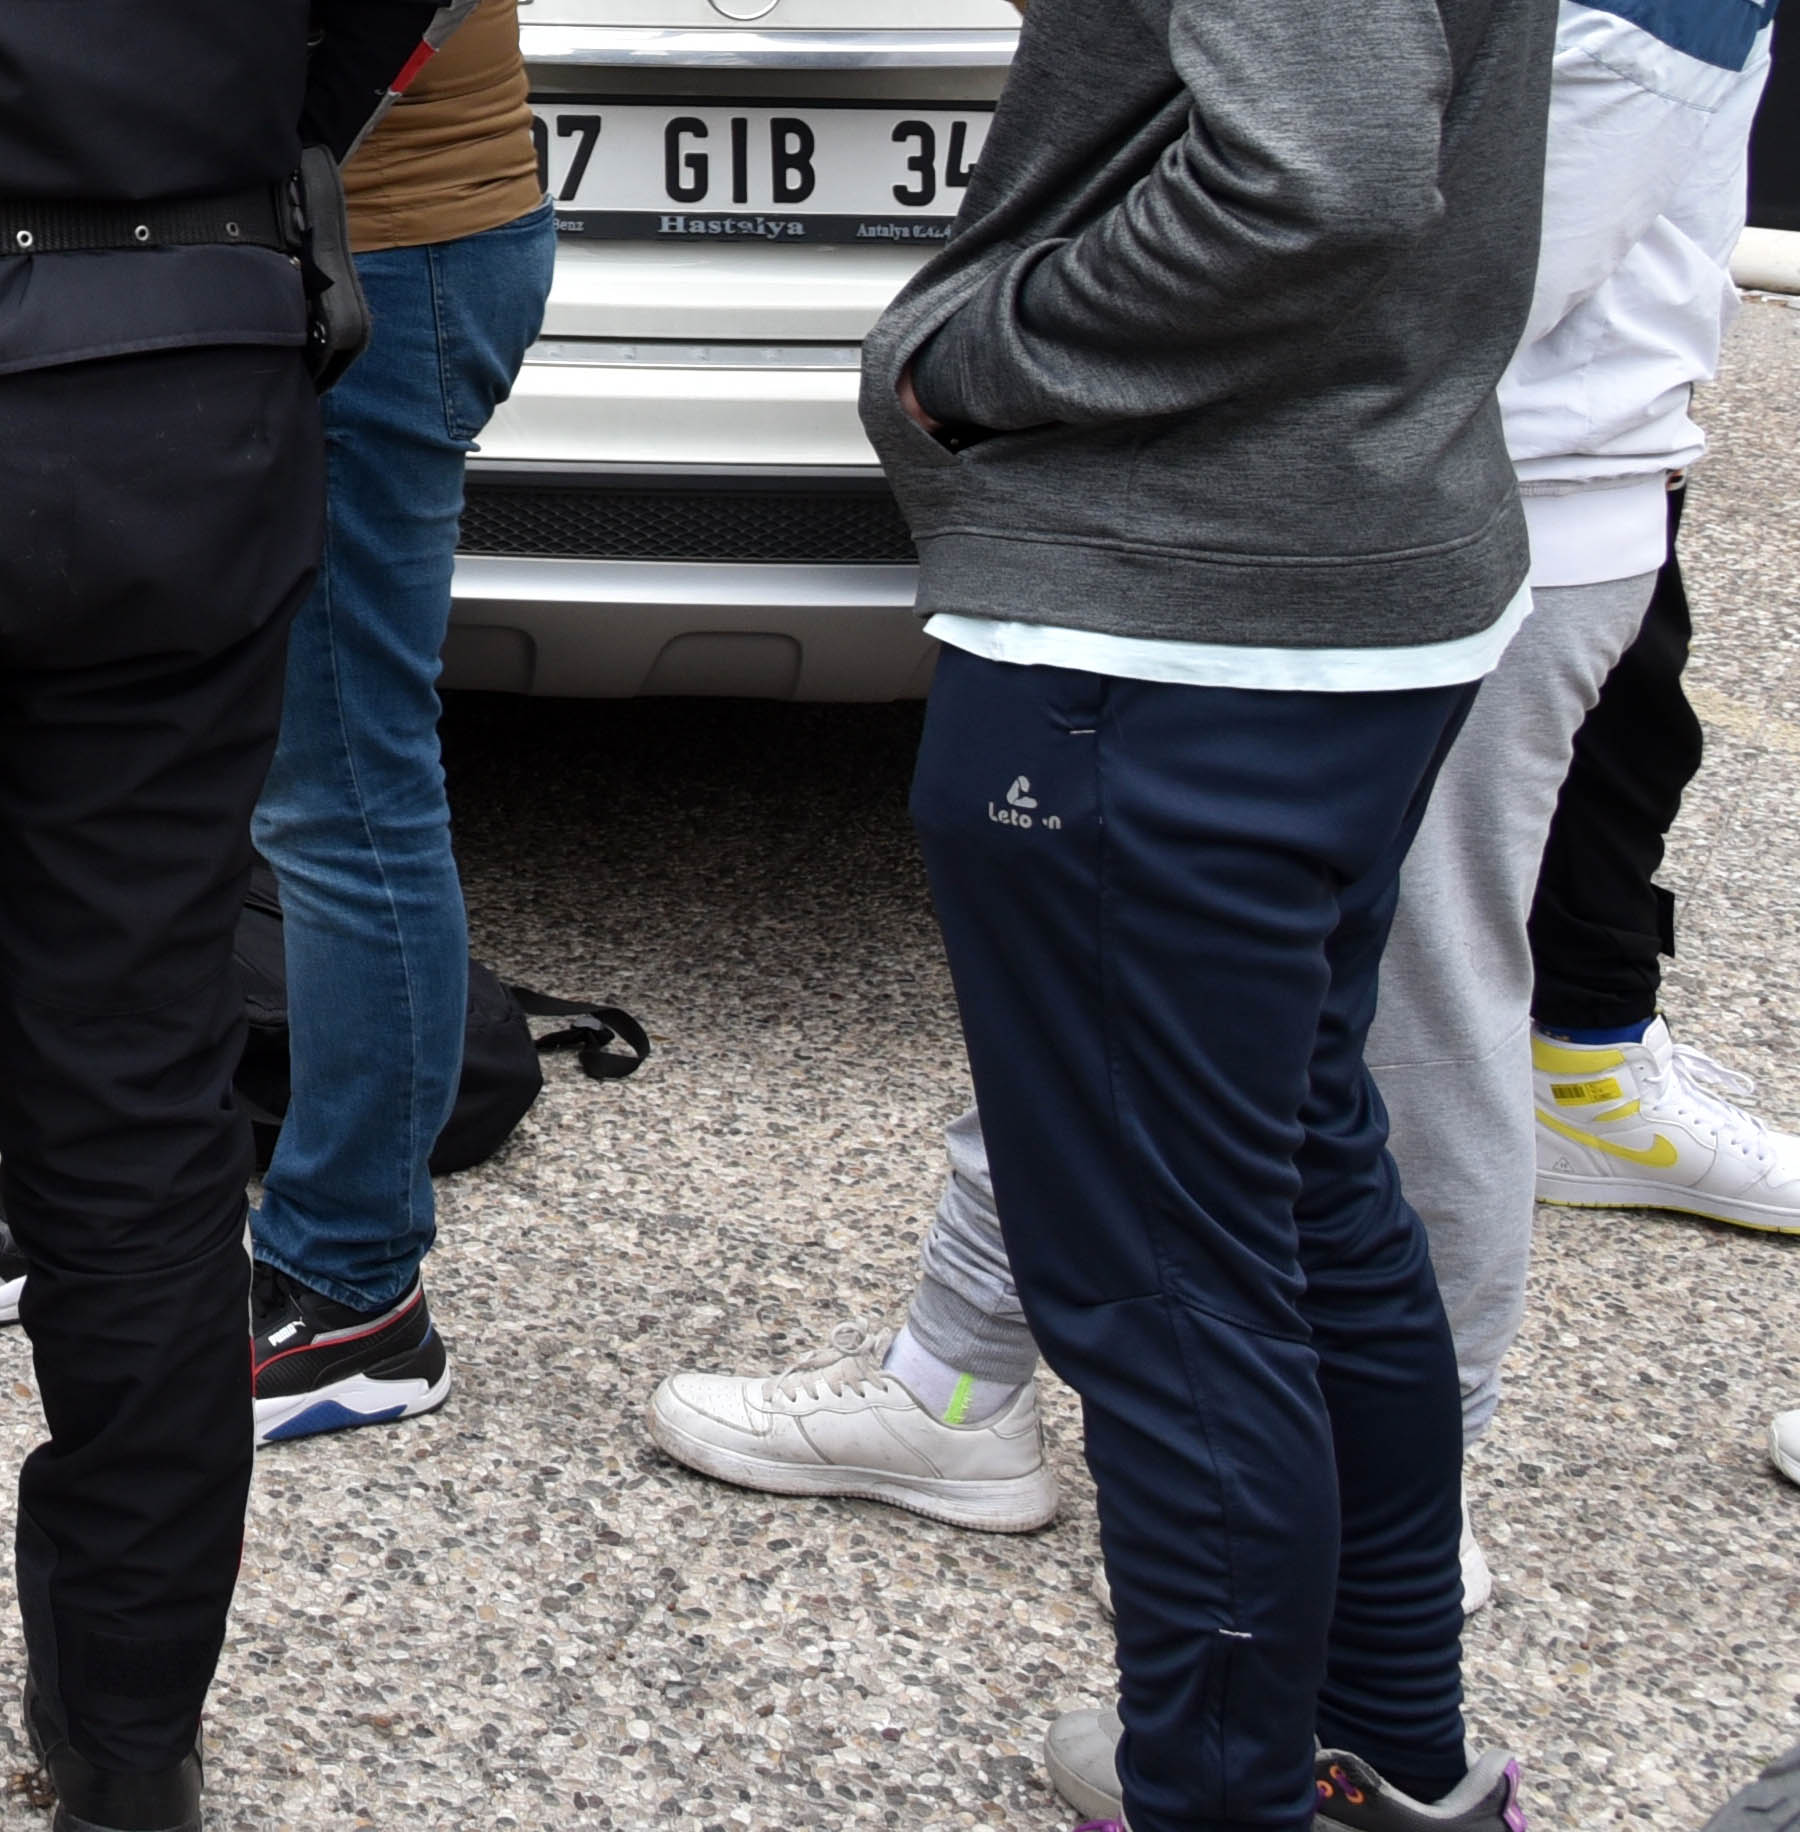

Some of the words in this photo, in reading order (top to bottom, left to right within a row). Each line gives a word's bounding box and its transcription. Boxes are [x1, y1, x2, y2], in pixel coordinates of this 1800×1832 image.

[663, 115, 817, 205] GIB
[891, 120, 978, 207] 34
[987, 801, 1062, 830] Leton
